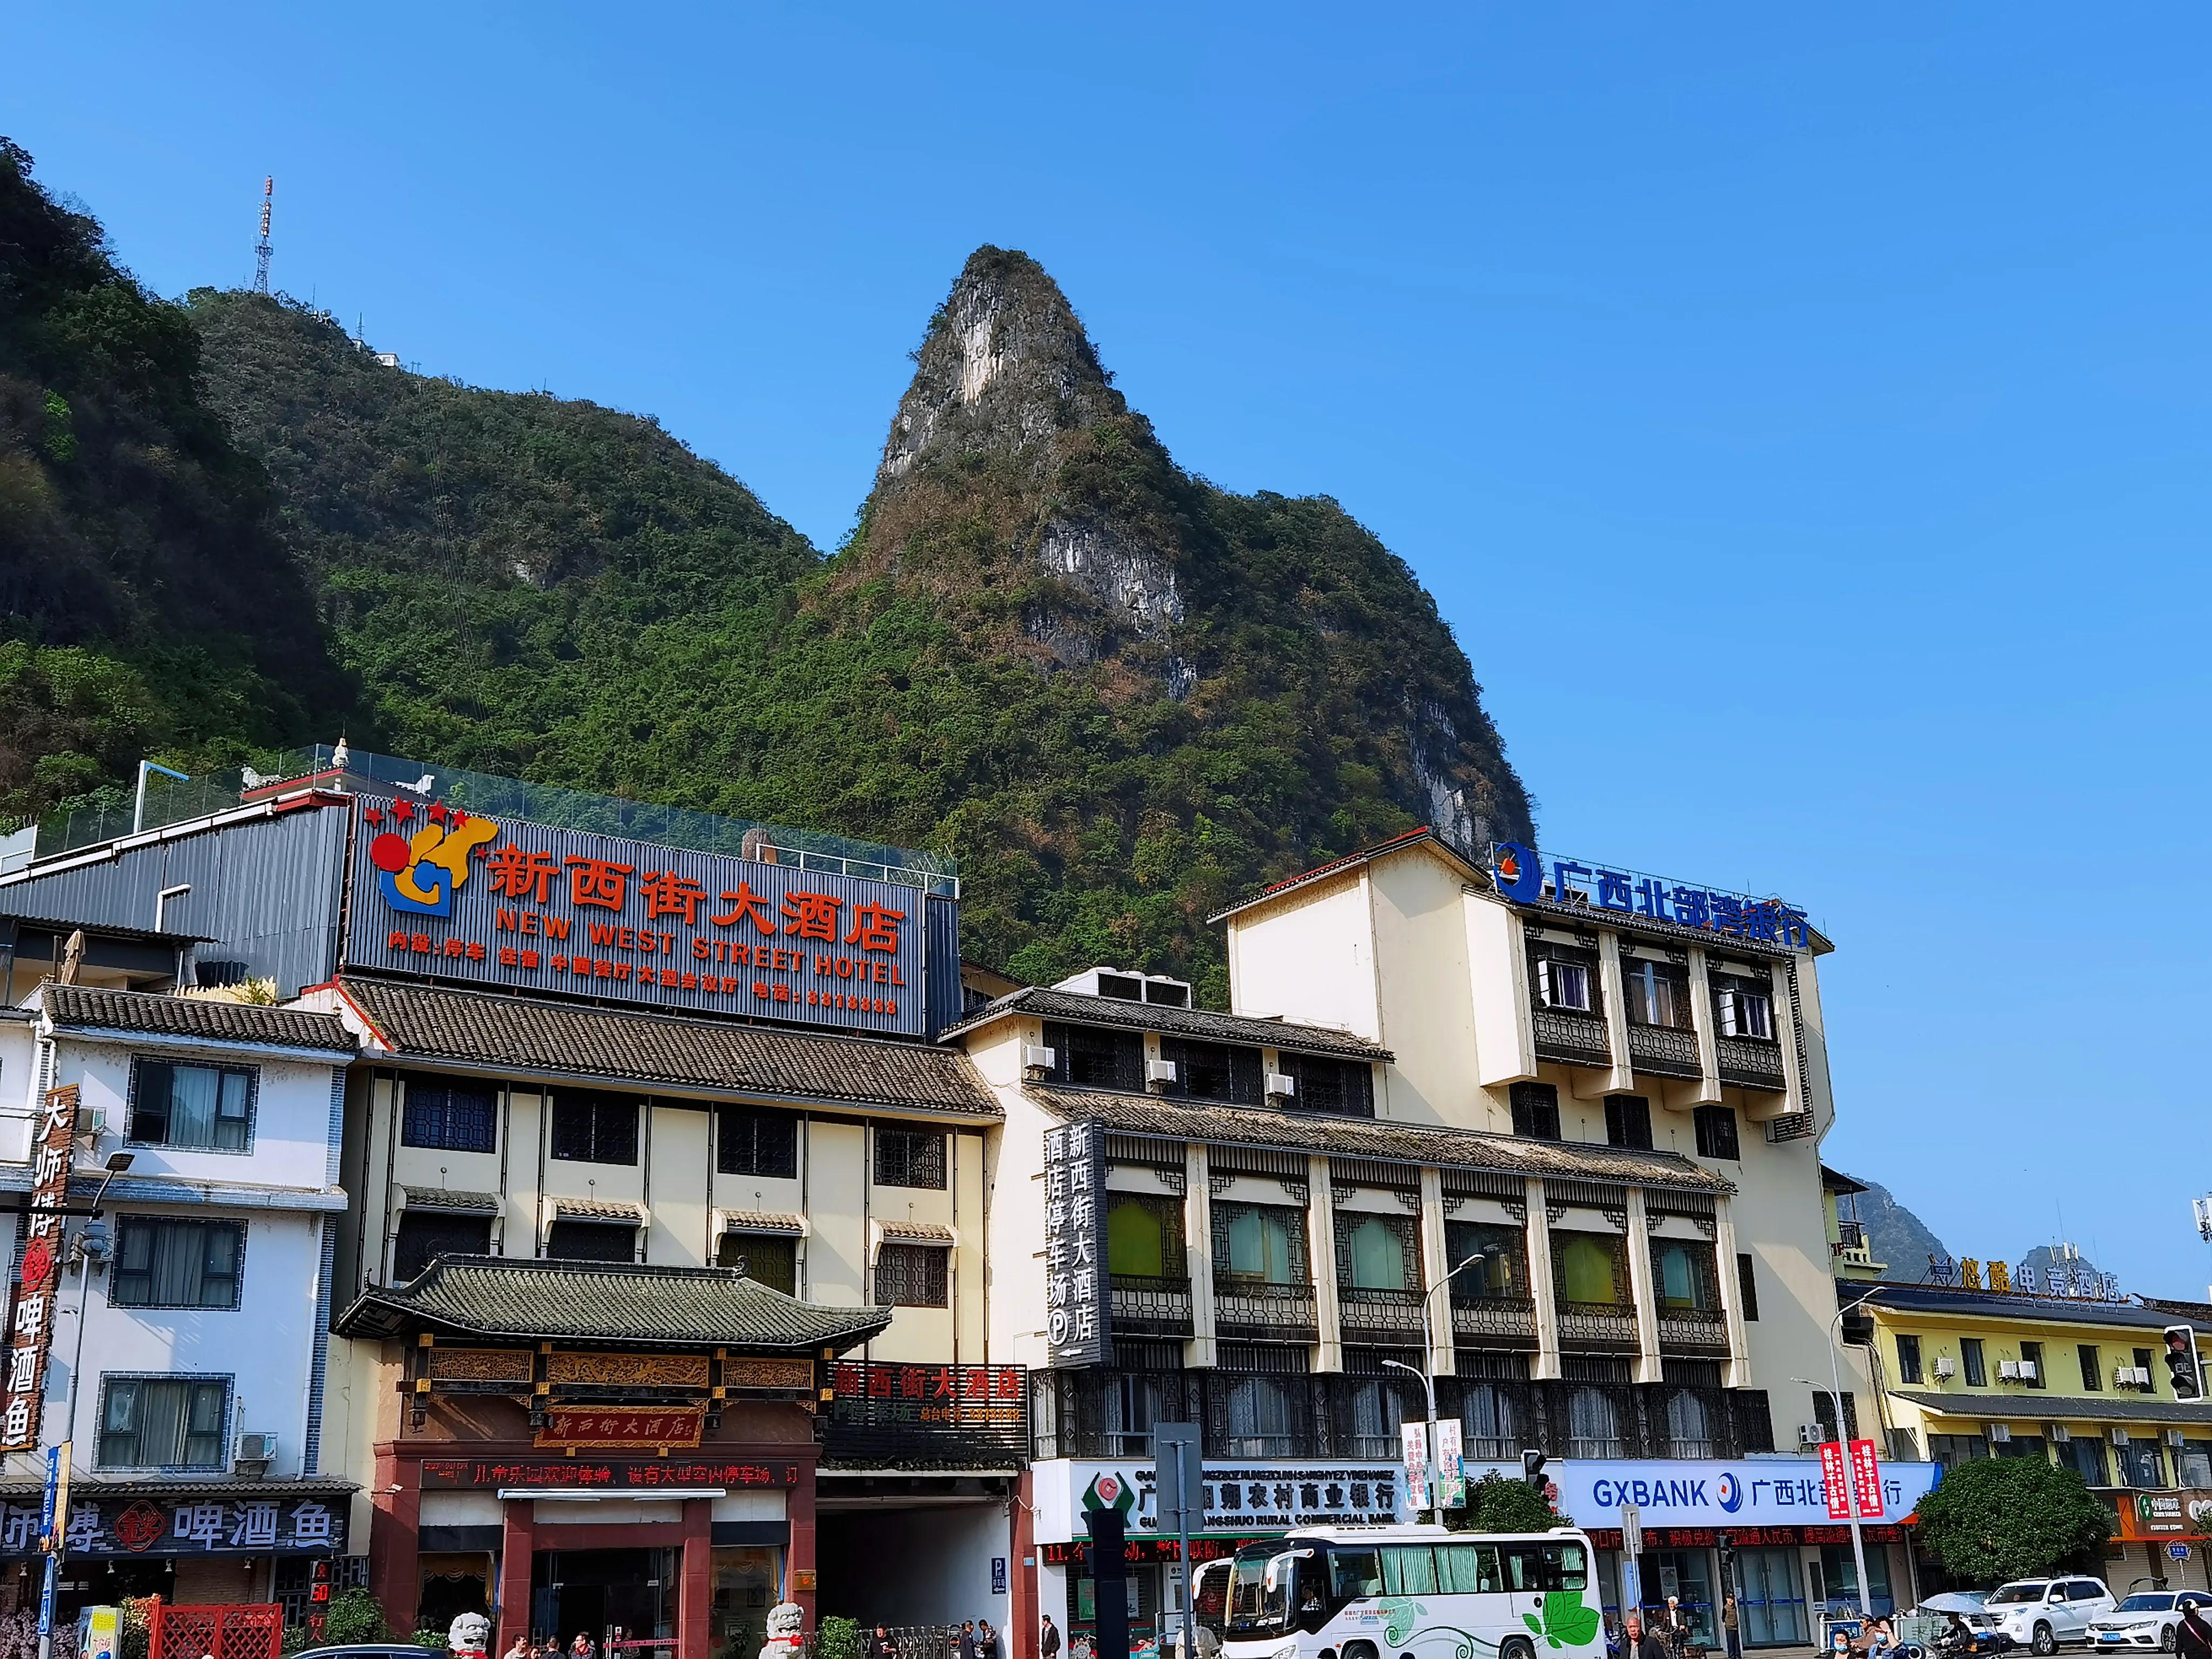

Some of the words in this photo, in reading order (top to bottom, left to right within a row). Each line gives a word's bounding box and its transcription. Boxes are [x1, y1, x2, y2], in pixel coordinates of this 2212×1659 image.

[487, 842, 904, 954] 新西街大酒店
[1553, 862, 1809, 947] 广西北部湾银行
[496, 907, 571, 940] NEW
[589, 921, 674, 955] WEST
[692, 937, 804, 972] STREET
[815, 954, 905, 986] HOTEL
[499, 946, 539, 968] 住宿
[1046, 1130, 1067, 1307] 酒店停车场
[1069, 1123, 1094, 1341] 新西街大酒店
[1, 1294, 44, 1446] 啤酒鱼
[834, 1365, 1020, 1399] 新西街大酒店
[554, 1414, 685, 1438] 新西街大酒店
[1593, 1479, 1709, 1507] GXBANK
[1823, 1448, 1839, 1509] 桂林千古情
[1862, 1445, 1879, 1507] 桂林千古情
[174, 1499, 330, 1550] 啤酒鱼
[1256, 1514, 1292, 1526] RURAL
[1295, 1513, 1366, 1525] COMMERCIAL
[1368, 1513, 1397, 1524] BANK
[995, 1560, 1002, 1577] P
